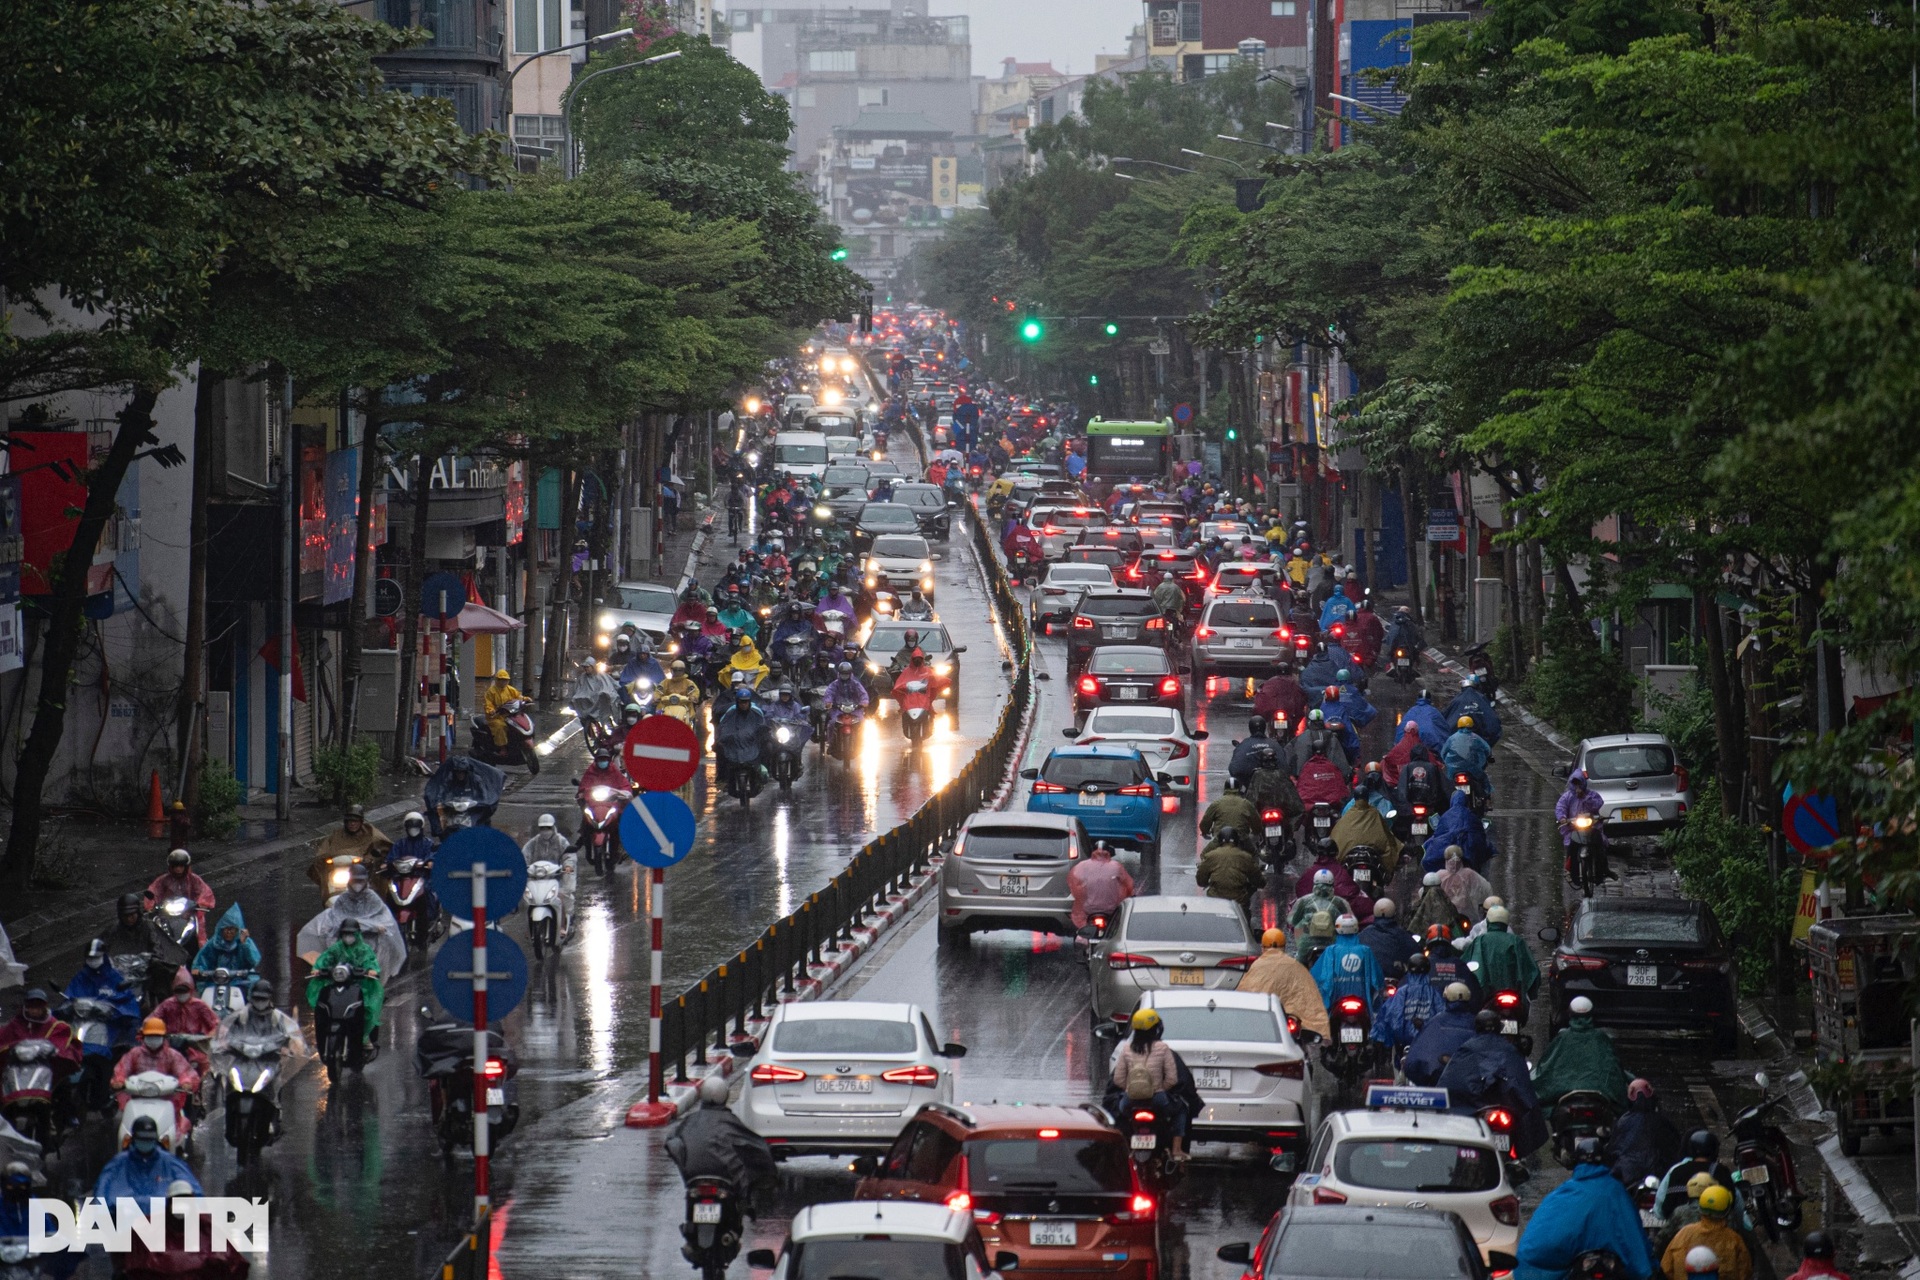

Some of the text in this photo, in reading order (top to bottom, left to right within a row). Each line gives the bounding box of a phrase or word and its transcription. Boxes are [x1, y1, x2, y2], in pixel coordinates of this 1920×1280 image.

[1007, 876, 1021, 885] 29A
[1344, 954, 1360, 972] hp
[1635, 966, 1650, 976] 30F
[1043, 1222, 1063, 1233] 30G
